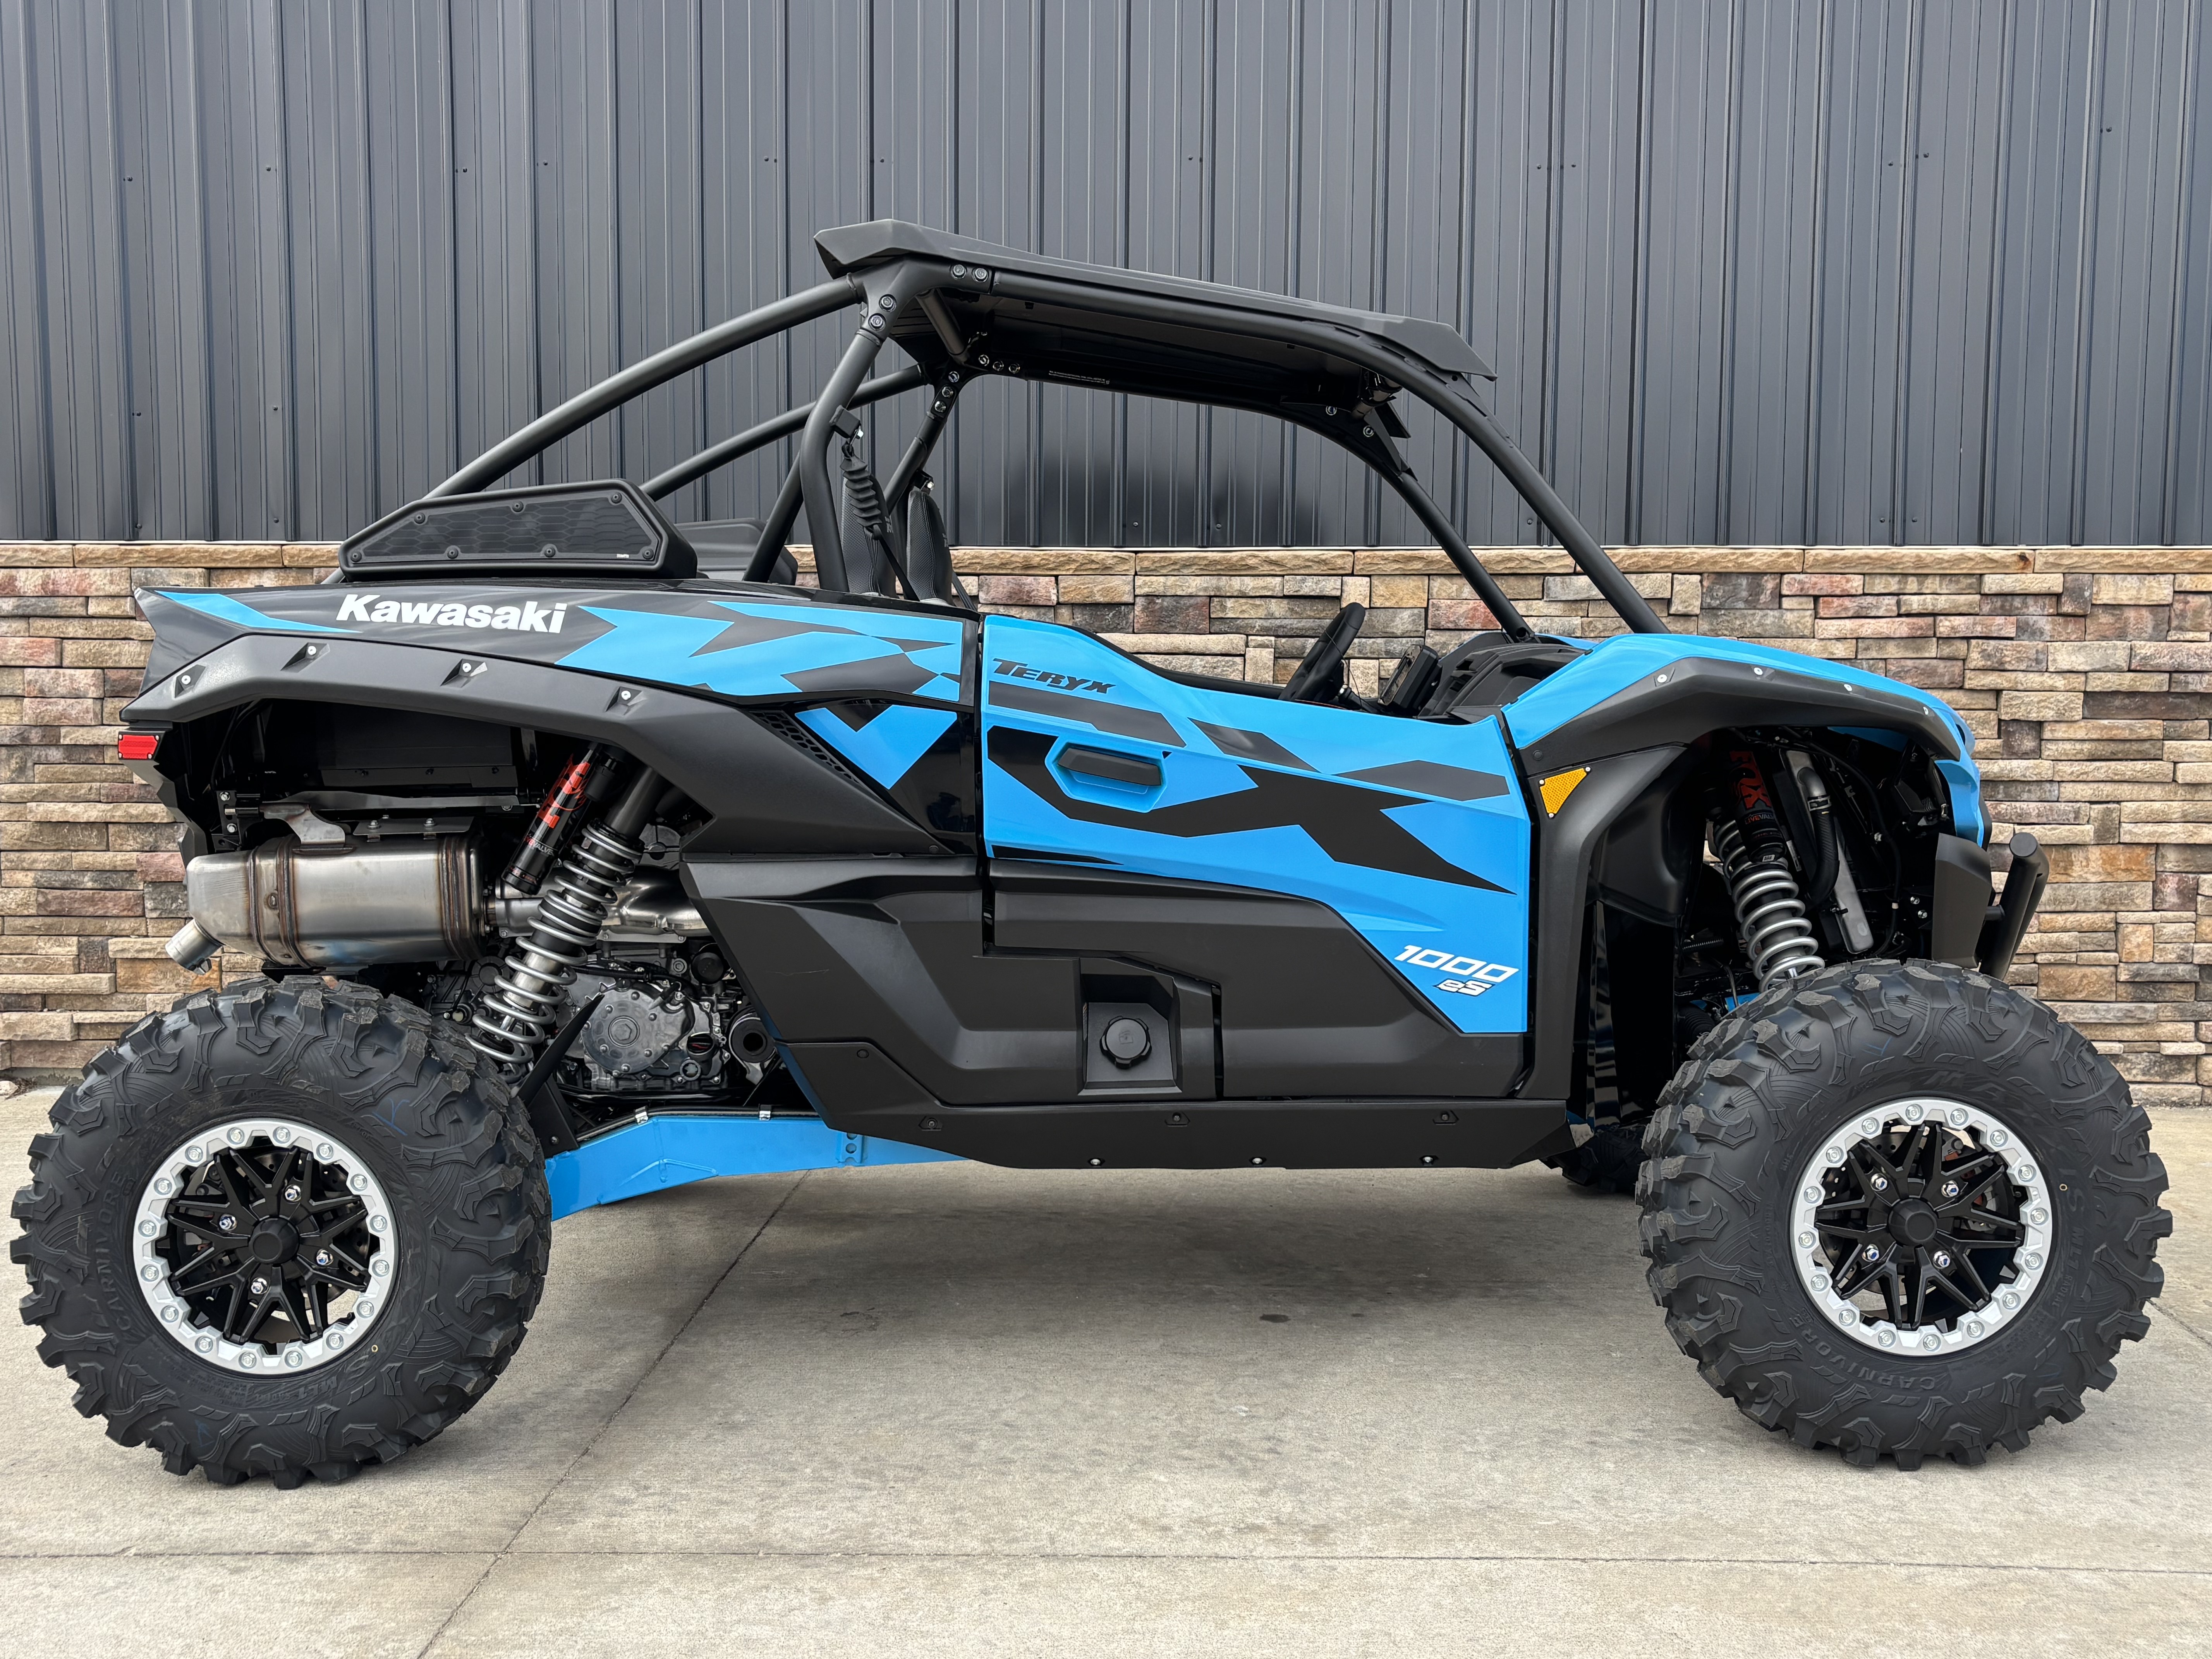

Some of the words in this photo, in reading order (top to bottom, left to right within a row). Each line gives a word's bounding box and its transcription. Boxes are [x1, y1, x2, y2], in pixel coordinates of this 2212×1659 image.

[337, 594, 567, 633] Kawasaki
[1729, 750, 1771, 809] FOX
[1394, 945, 1519, 982] 1000
[96, 1173, 132, 1331] CARNIVORE
[2051, 1274, 2074, 1309] RADIAL
[1785, 1311, 1935, 1390] CARNIVORE
